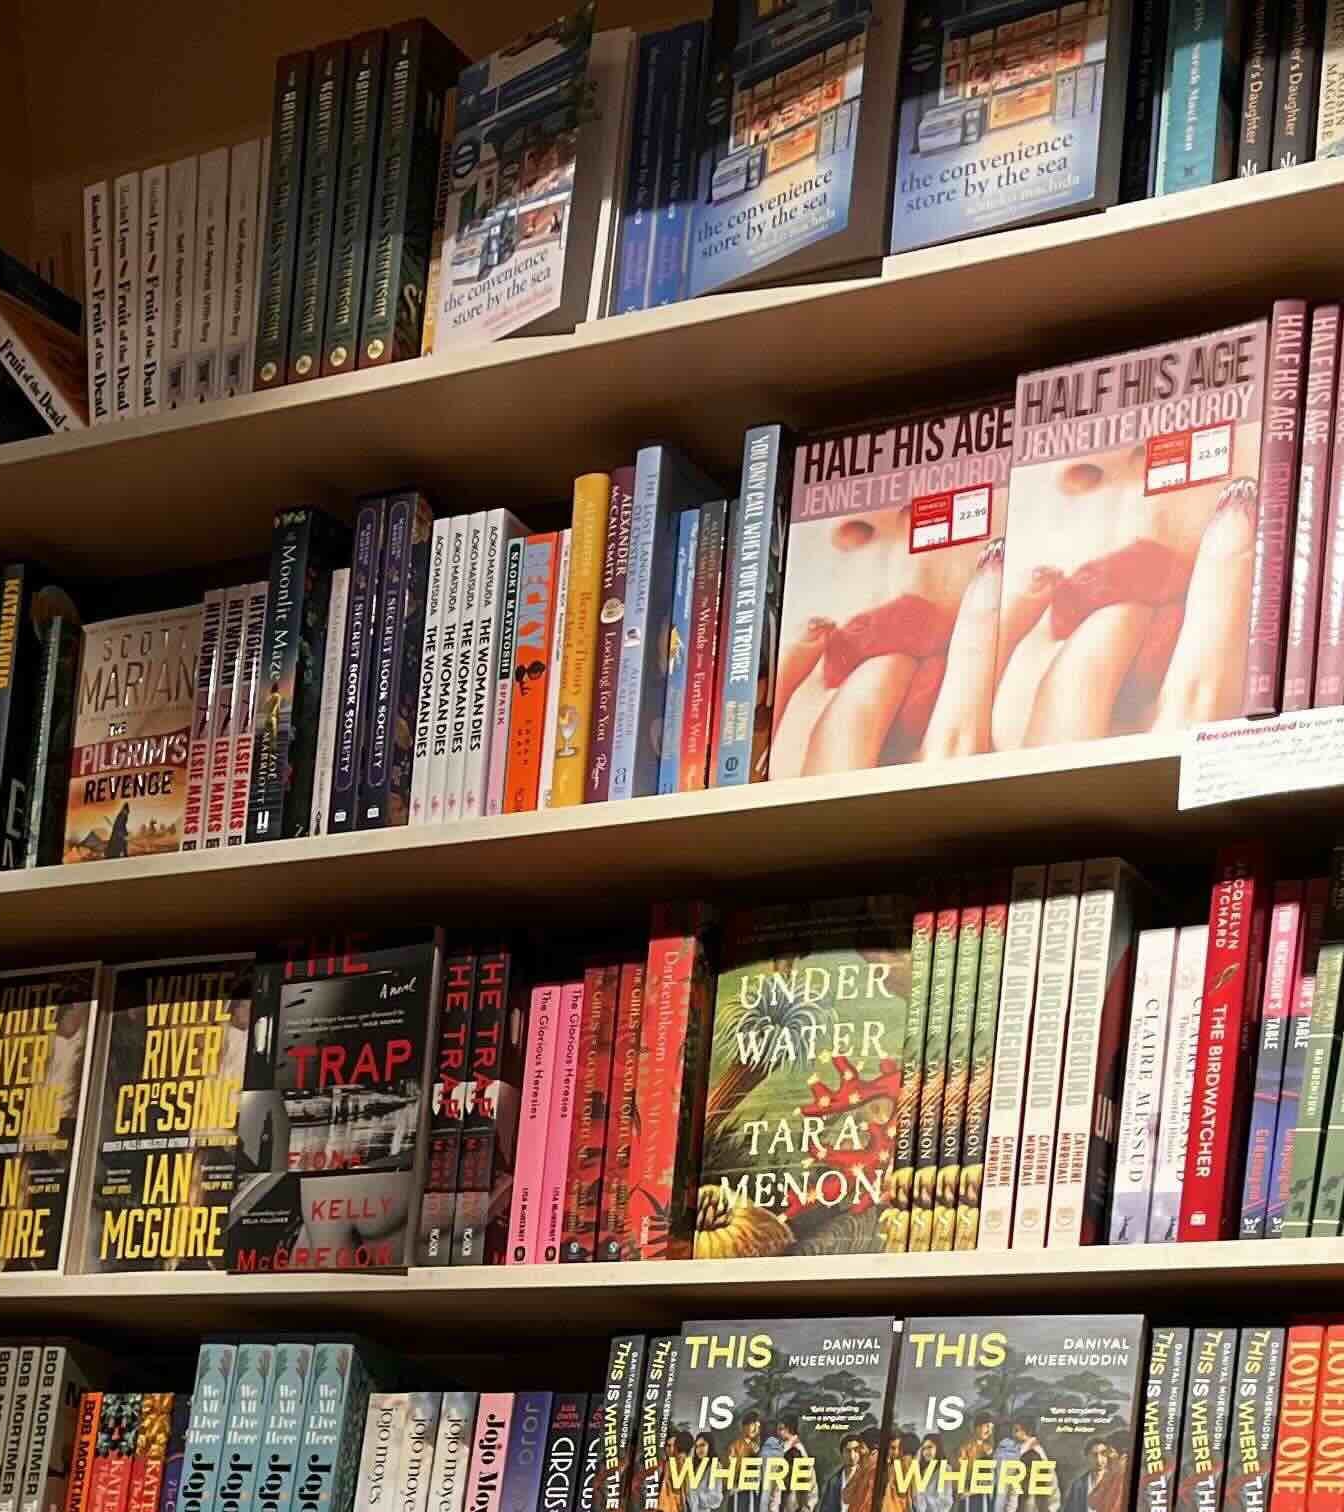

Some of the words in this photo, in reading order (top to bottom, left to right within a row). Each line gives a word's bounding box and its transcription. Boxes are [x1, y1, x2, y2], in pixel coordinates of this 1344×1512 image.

[901, 168, 933, 193] the
[939, 132, 1073, 186] convenience
[905, 190, 956, 213] store
[997, 164, 1026, 188] the
[1036, 155, 1067, 176] sea
[804, 436, 884, 483] HALF
[894, 424, 947, 469] HIS
[953, 405, 1012, 454] AGE
[1196, 720, 1297, 742] Recommended
[83, 771, 174, 801] REVENGE
[739, 962, 893, 1007] UNDER
[1209, 1005, 1226, 1041] THE
[143, 1025, 221, 1080] RIVER
[288, 1040, 412, 1091] TRAP
[734, 1021, 889, 1070] WATER
[1194, 1044, 1226, 1179] BIRDWATCHER
[742, 1120, 865, 1158] TARA
[143, 1152, 195, 1206] IAN
[719, 1169, 885, 1209] MENON
[100, 1206, 229, 1260] MCGUIRE
[910, 1333, 1007, 1368] THIS
[1025, 1354, 1128, 1367] MUEENUDDIN
[1064, 1338, 1129, 1350] DANIYAL
[78, 1399, 95, 1434] BOB
[926, 1396, 964, 1430] IS
[893, 1459, 1057, 1495] WHERE
